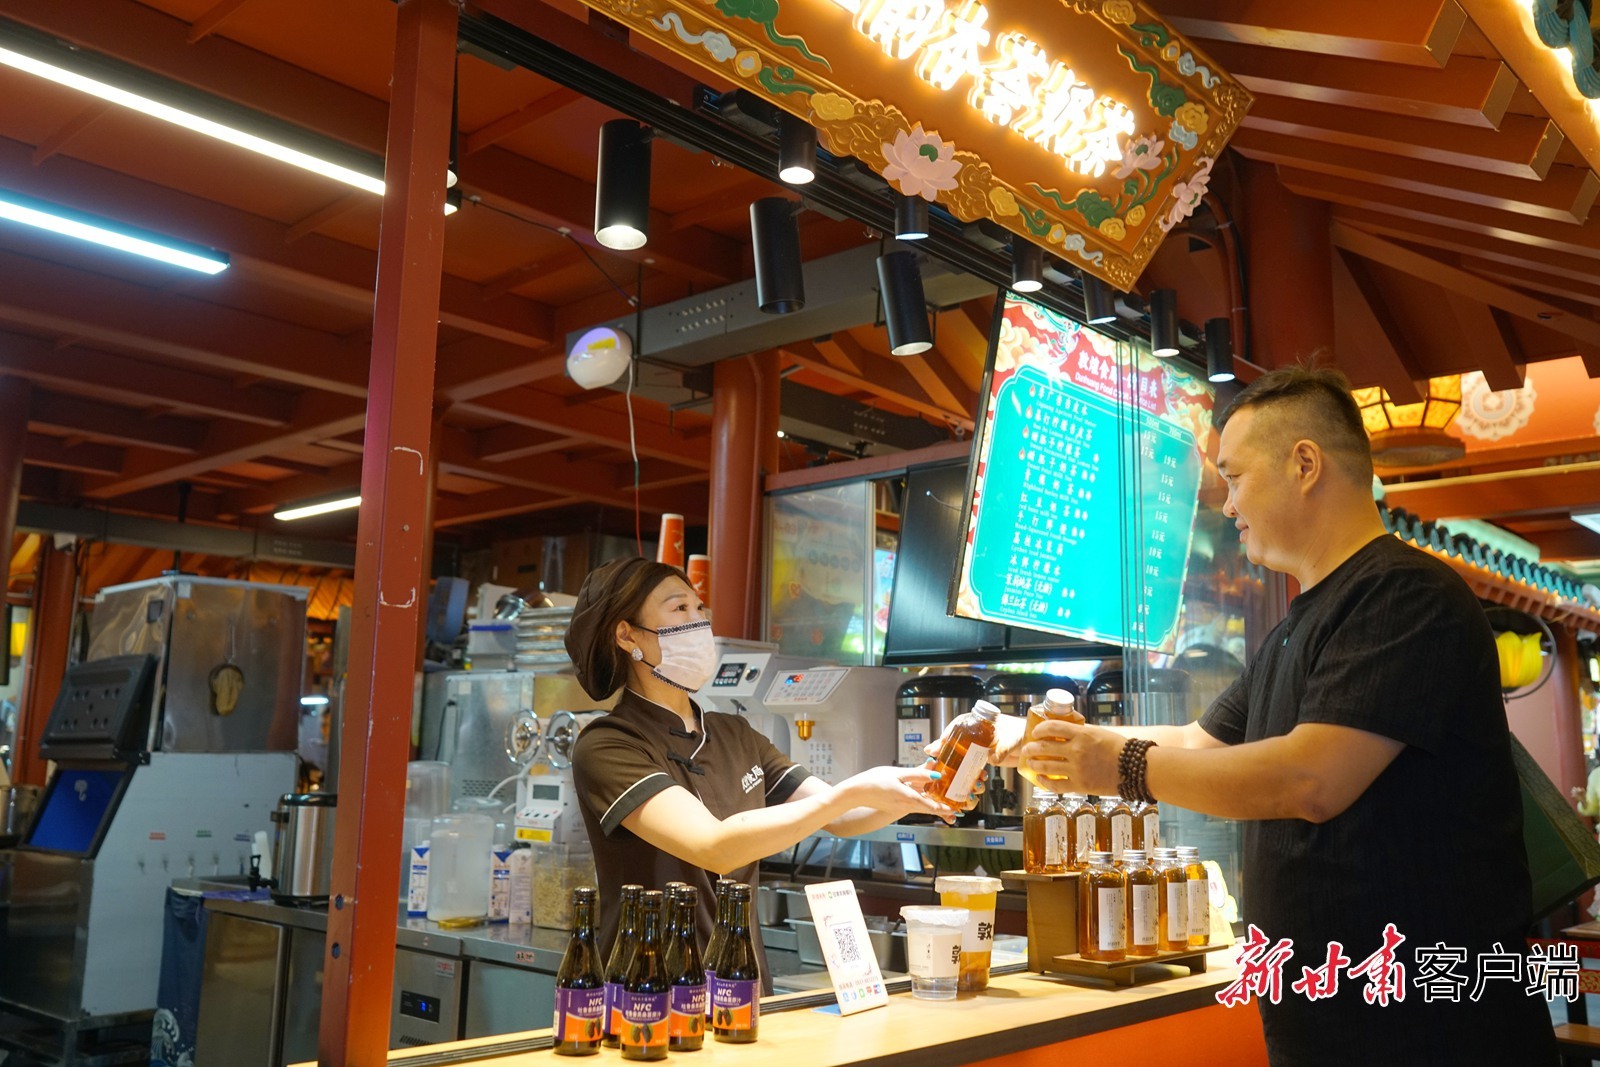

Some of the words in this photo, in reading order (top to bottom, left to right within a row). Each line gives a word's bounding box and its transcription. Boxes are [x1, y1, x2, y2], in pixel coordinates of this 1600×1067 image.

[1099, 382, 1113, 395] Food
[717, 988, 732, 997] NFC
[633, 1003, 652, 1012] NFC
